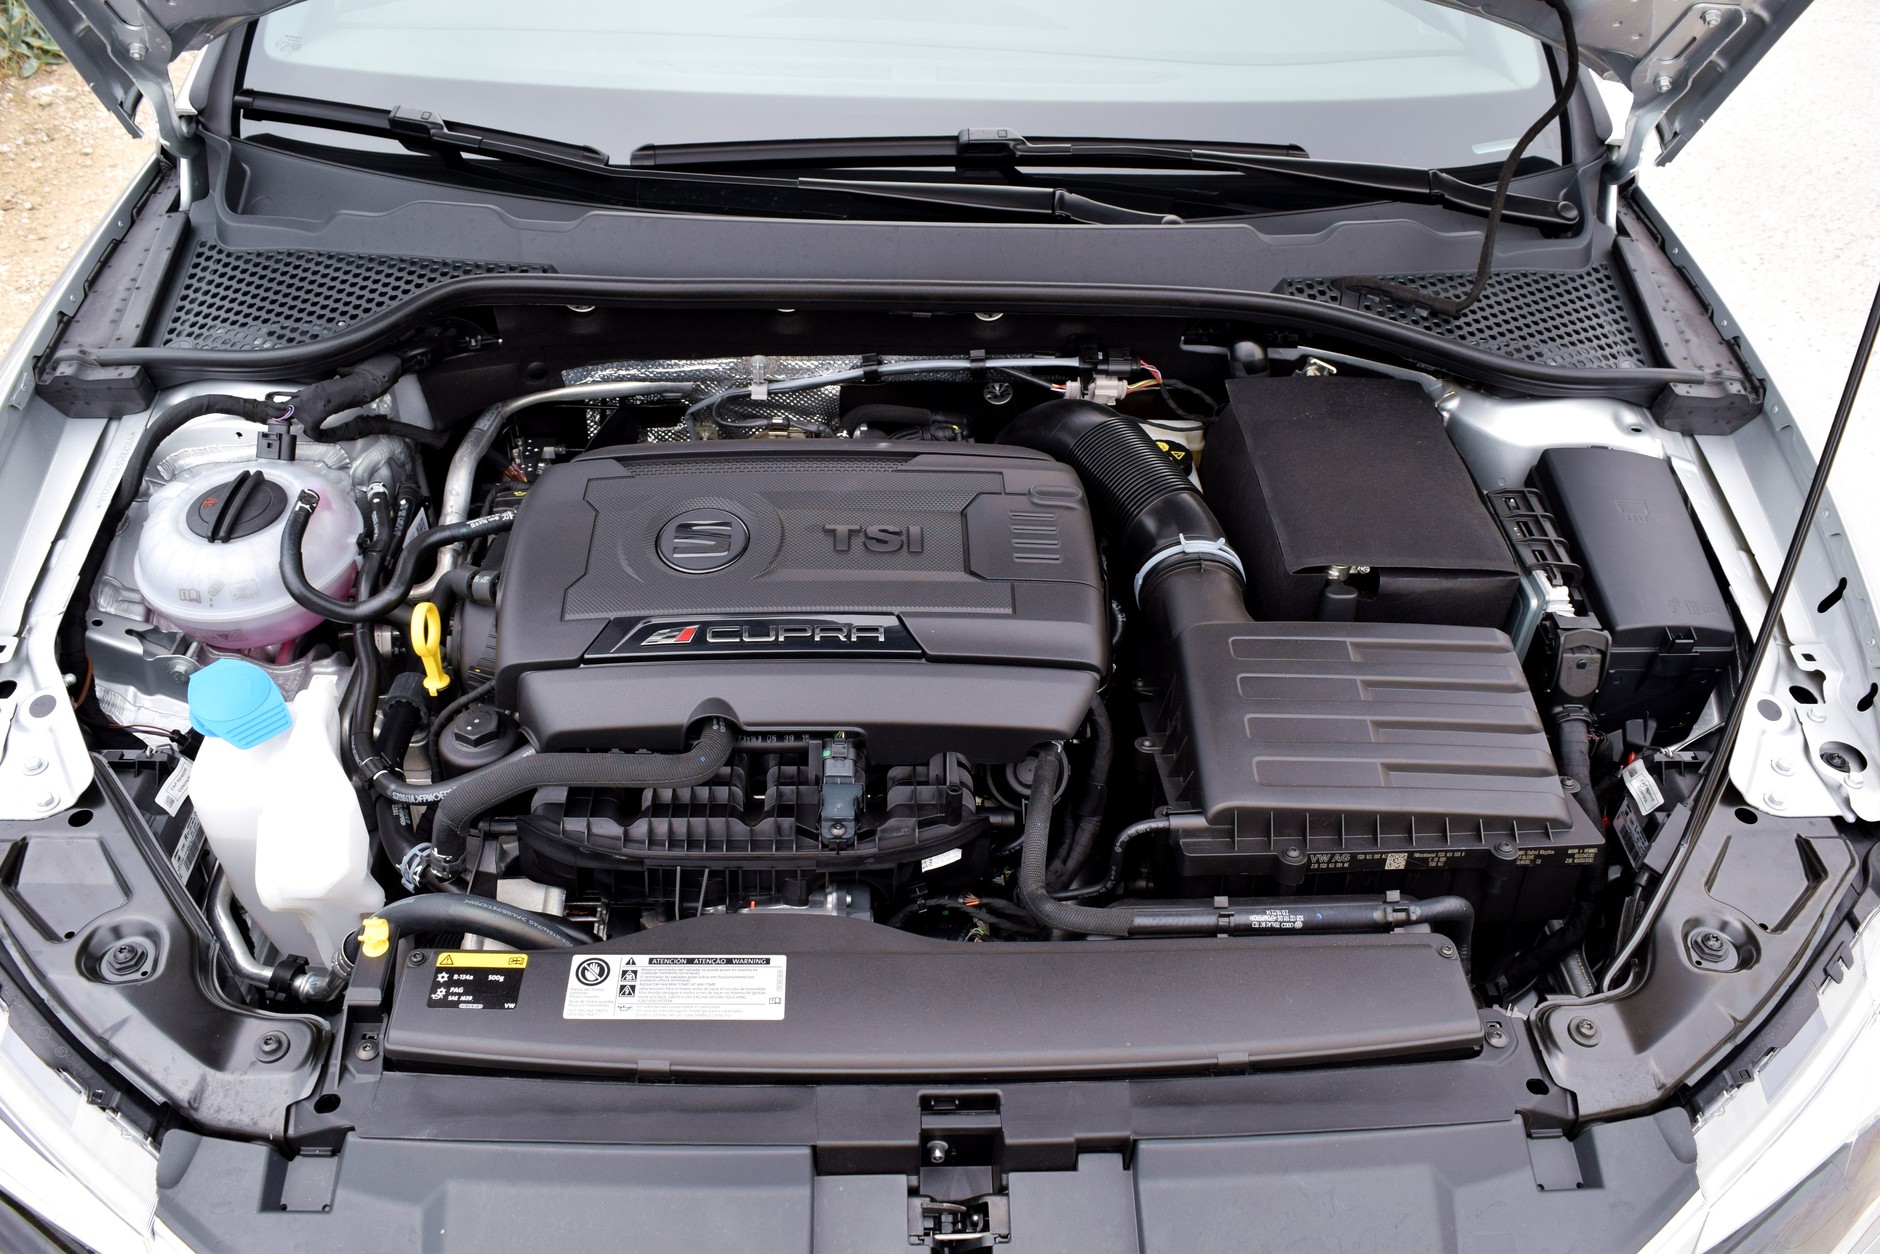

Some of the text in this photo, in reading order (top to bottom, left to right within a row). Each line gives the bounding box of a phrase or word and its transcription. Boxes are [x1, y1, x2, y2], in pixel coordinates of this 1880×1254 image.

[823, 523, 924, 553] TSI
[705, 625, 885, 643] CUPRA
[1310, 854, 1330, 863] VW
[1332, 853, 1350, 862] AG
